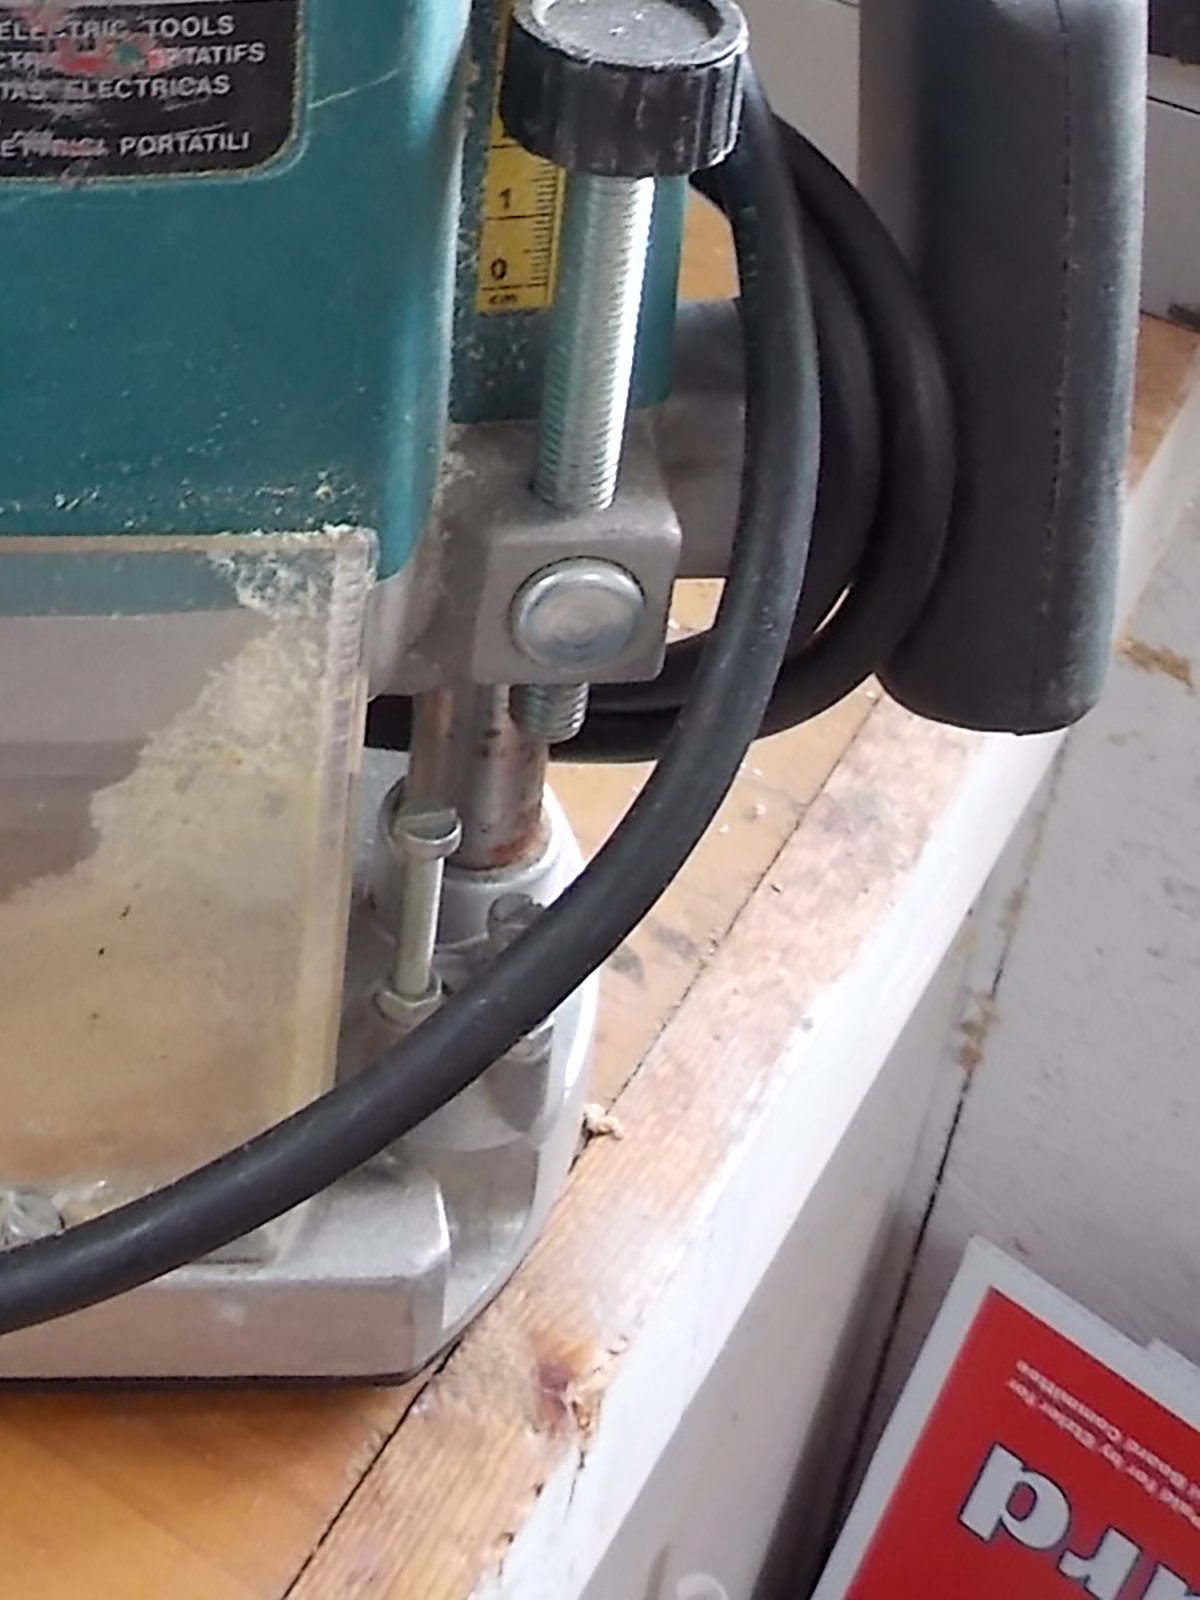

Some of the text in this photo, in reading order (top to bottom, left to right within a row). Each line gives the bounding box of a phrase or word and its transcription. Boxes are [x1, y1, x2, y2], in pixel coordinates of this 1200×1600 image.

[145, 14, 235, 38] TOOLS
[119, 131, 250, 157] PORTATILI
[498, 188, 511, 209] 1
[490, 258, 508, 281] 0
[1014, 1358, 1189, 1491] Board Committee
